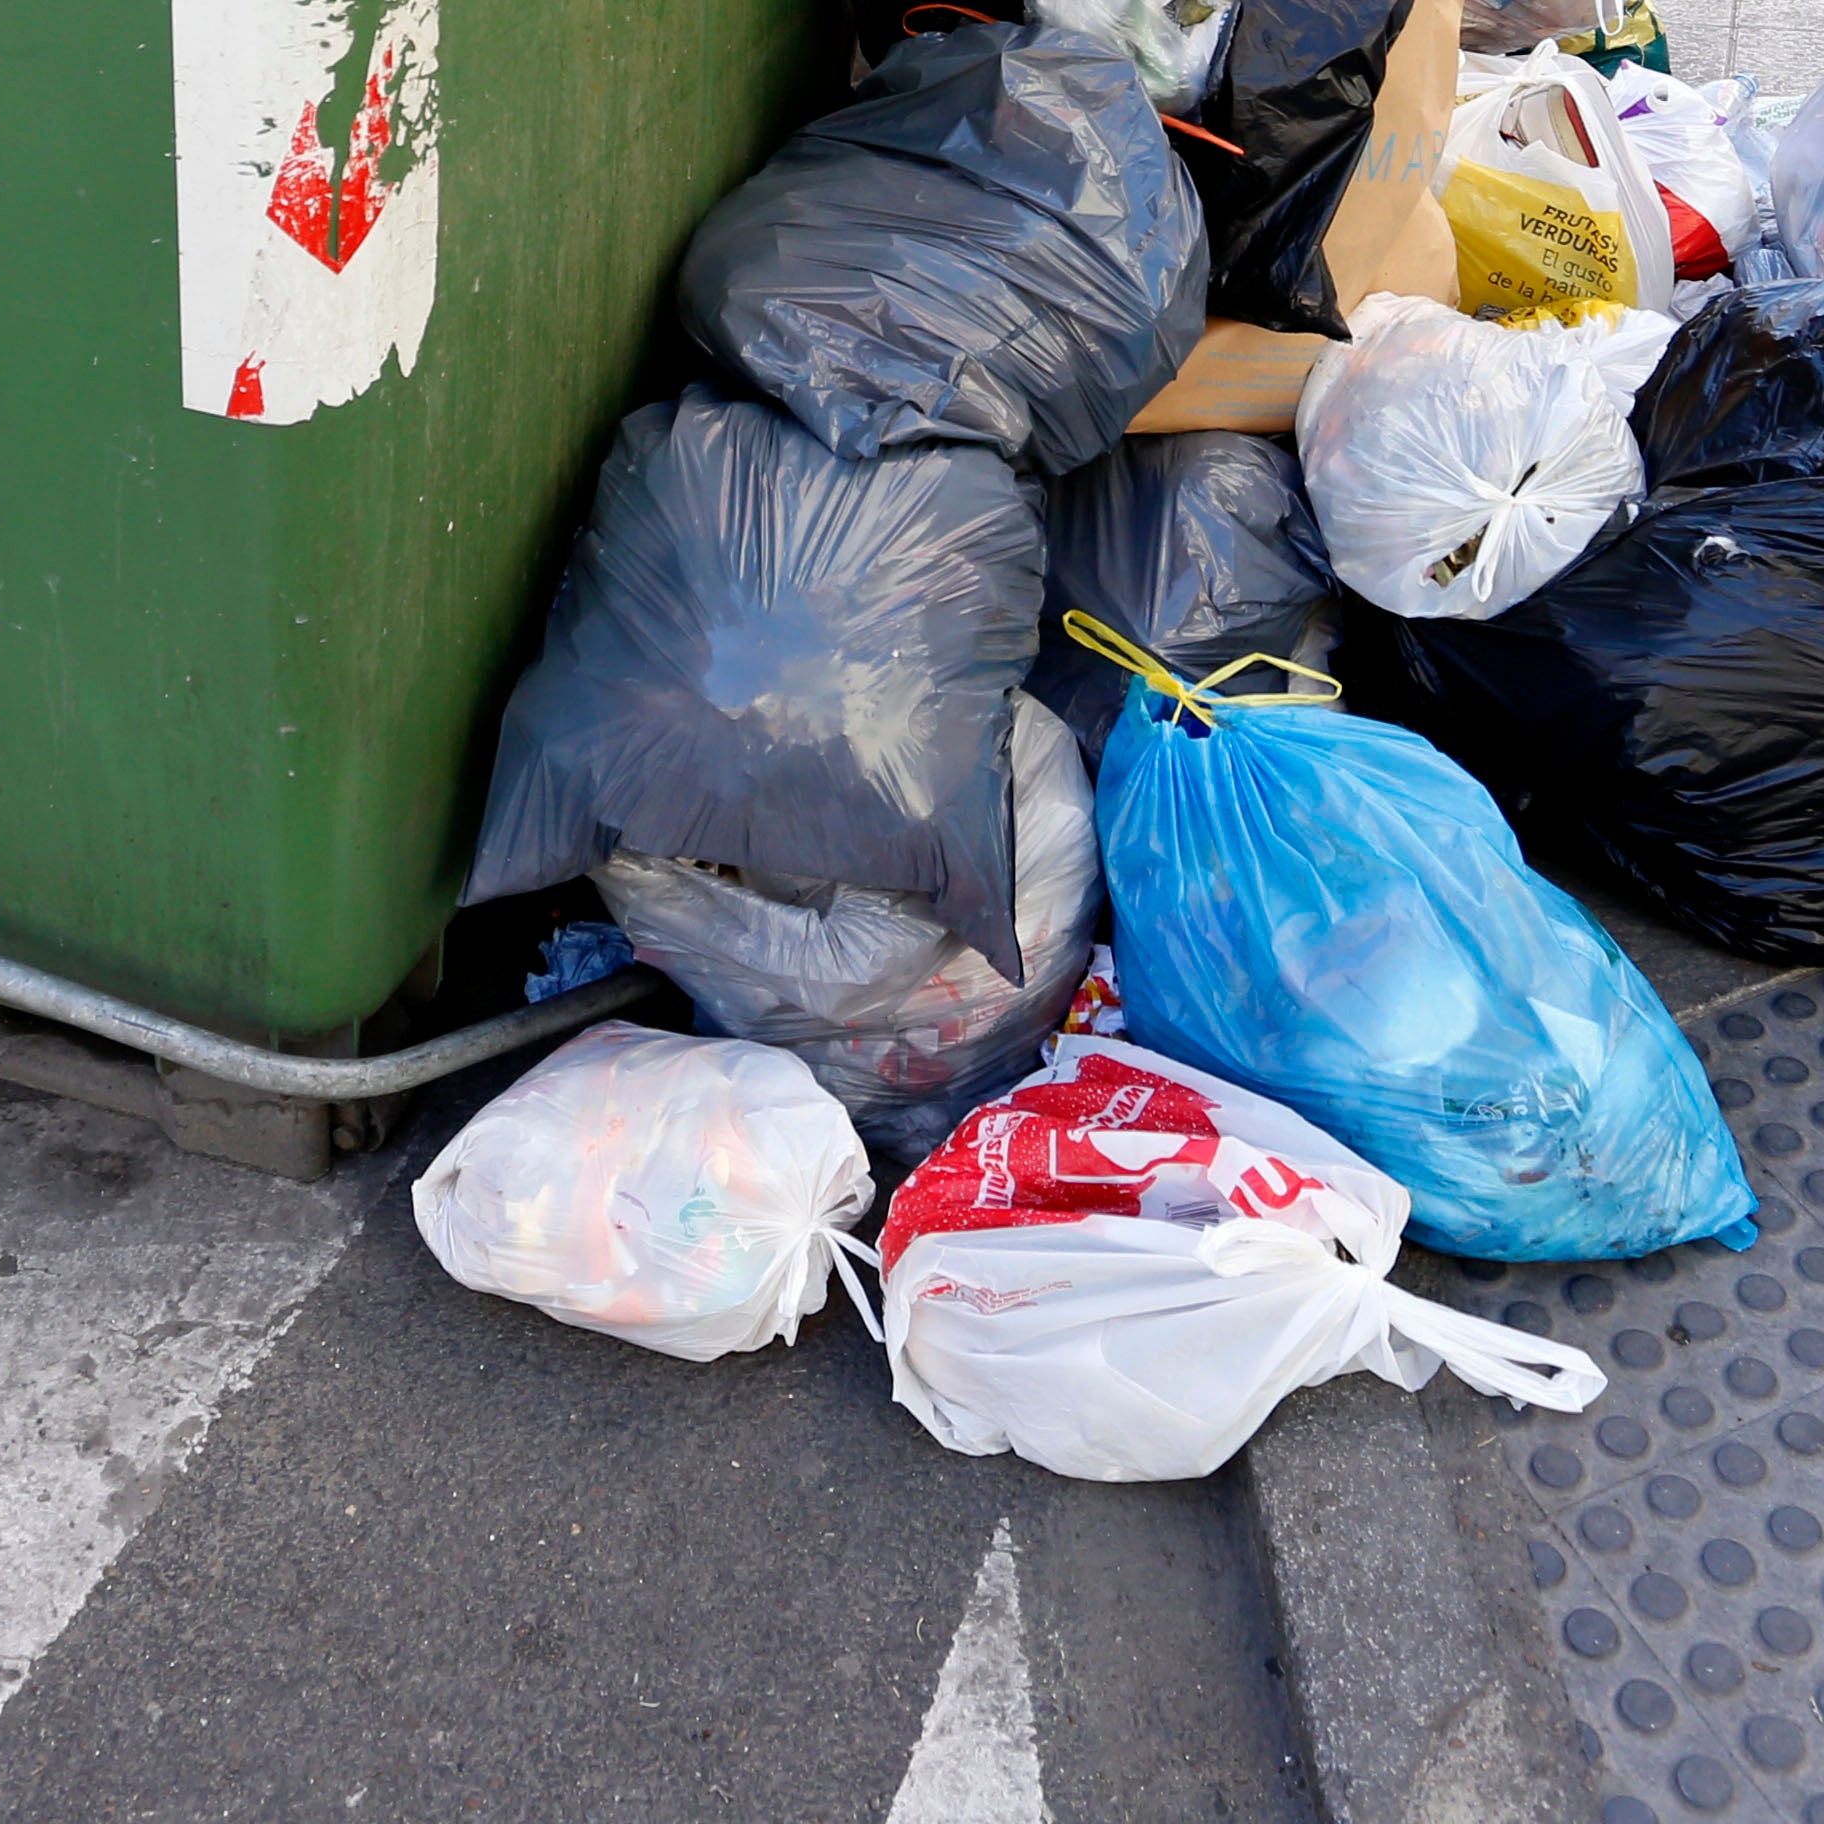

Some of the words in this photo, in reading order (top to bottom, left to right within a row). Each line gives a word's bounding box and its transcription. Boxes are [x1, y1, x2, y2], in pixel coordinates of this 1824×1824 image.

[1520, 212, 1619, 274] VERDURAS
[1542, 204, 1614, 250] FRUTAS
[1487, 270, 1513, 289] de
[1517, 280, 1535, 299] la
[1542, 248, 1559, 269] El
[1562, 258, 1614, 294] gusto
